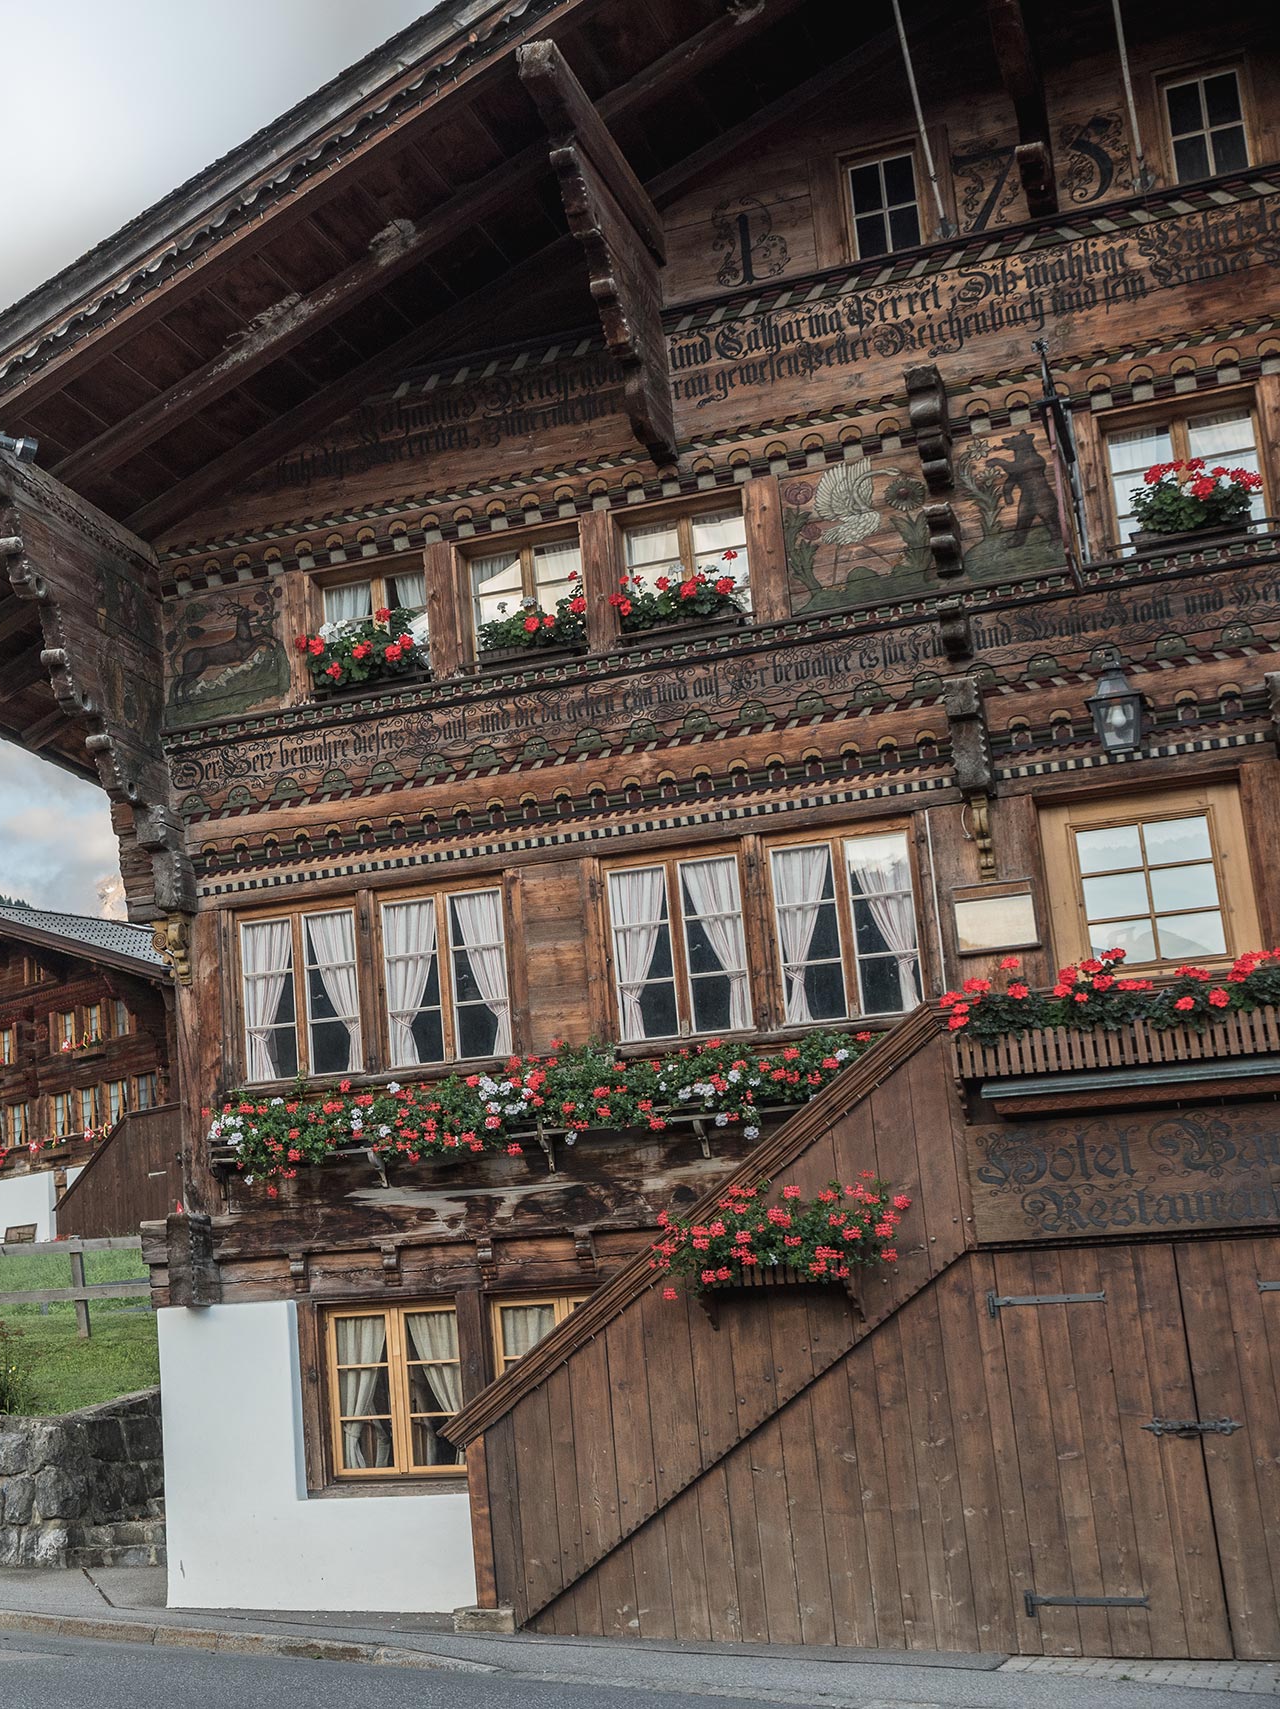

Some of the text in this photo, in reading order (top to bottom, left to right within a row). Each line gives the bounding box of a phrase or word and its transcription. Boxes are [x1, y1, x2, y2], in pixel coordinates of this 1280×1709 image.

[669, 330, 712, 370] und
[279, 729, 349, 769] bewahre
[480, 701, 510, 734] und
[515, 694, 537, 728] die
[541, 696, 562, 724] da
[656, 674, 687, 703] und
[858, 650, 878, 670] es
[974, 616, 1012, 650] und
[1184, 584, 1224, 614] und
[977, 1126, 1138, 1186] Hotel
